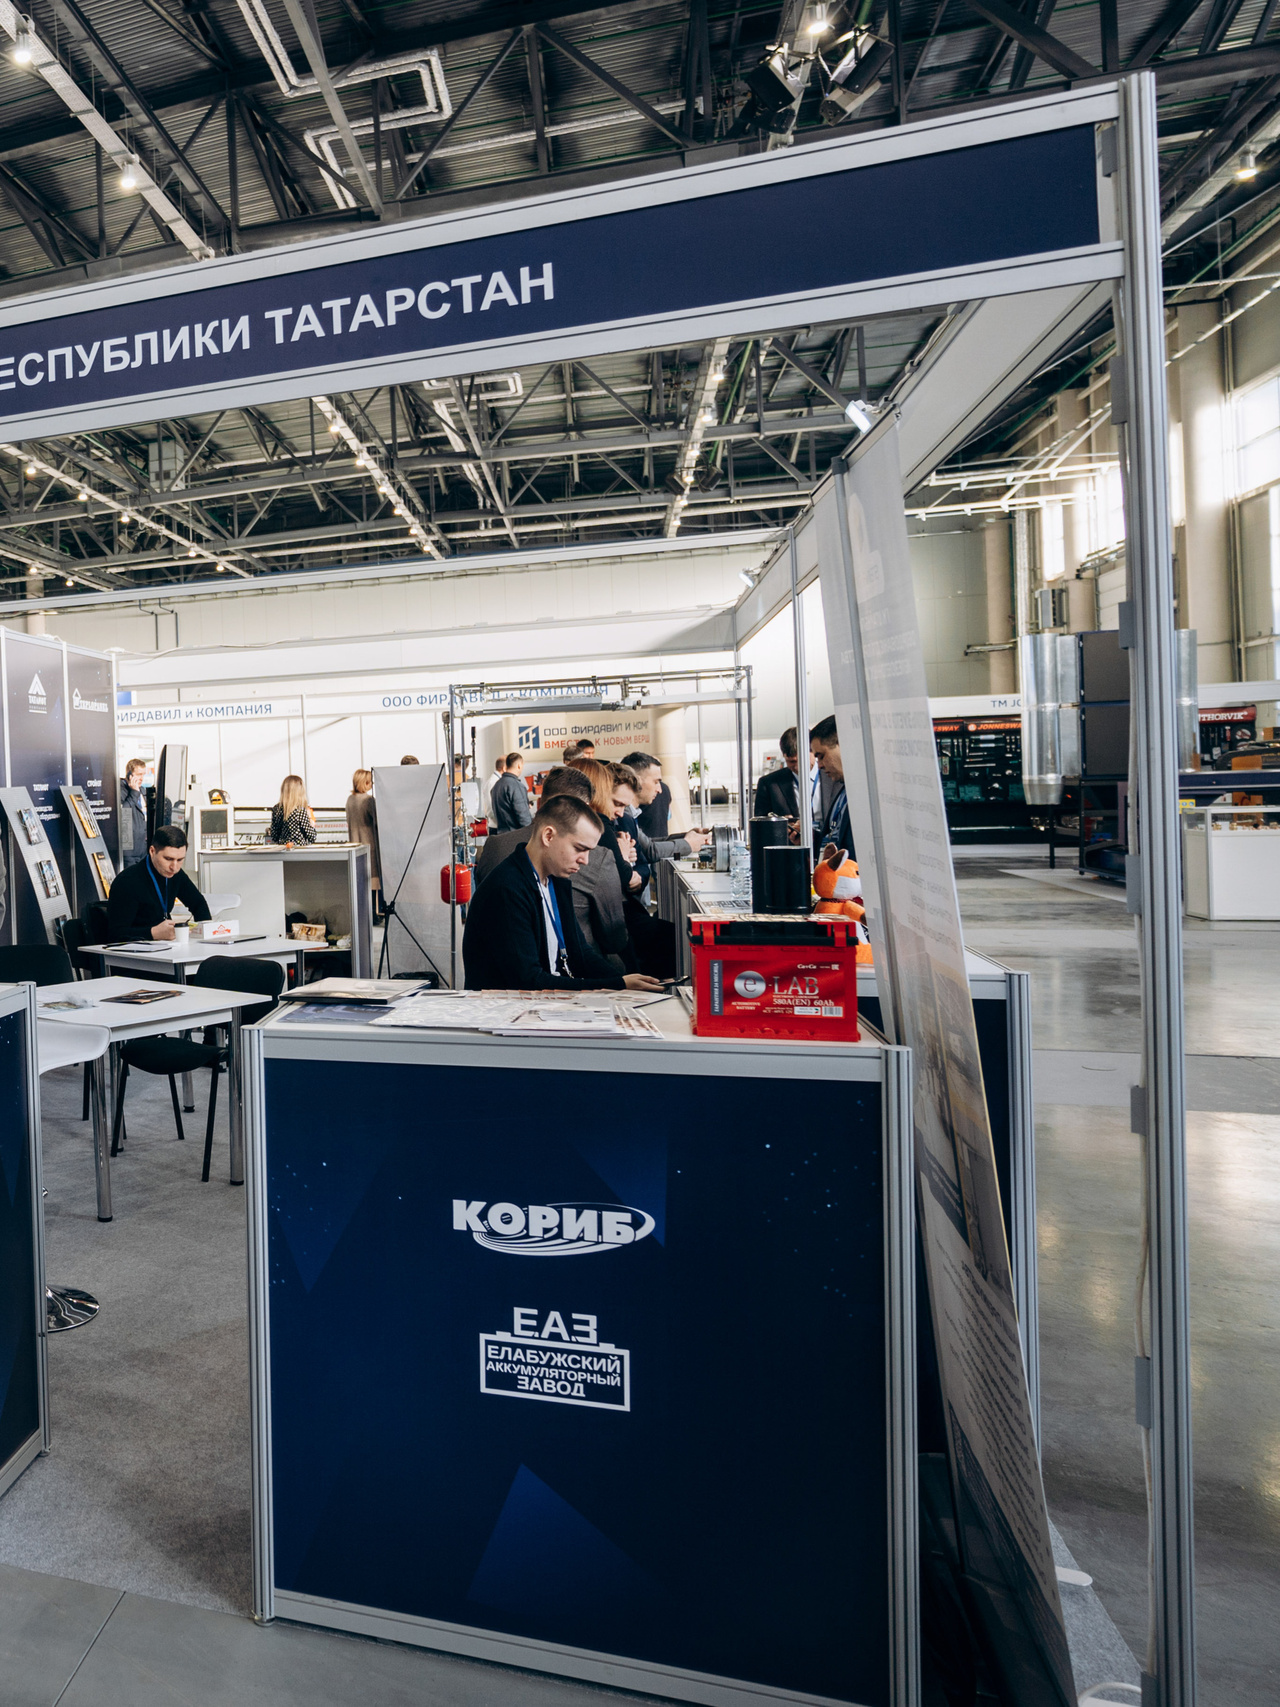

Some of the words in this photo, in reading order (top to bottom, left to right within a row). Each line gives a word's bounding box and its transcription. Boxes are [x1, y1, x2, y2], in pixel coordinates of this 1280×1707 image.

[265, 262, 554, 345] ТАТАРСТАН
[196, 703, 272, 718] КОМПАНИЯ
[382, 695, 412, 708] ООО
[543, 727, 568, 737] ООО
[603, 735, 632, 746] НОВЫМ
[452, 1198, 637, 1246] КОРИБ
[513, 1306, 598, 1345] ЕАЗ
[487, 1345, 621, 1374] ЕЛАБУЖСКИЙ
[486, 1360, 621, 1388] АККУМУЛЯТОРНЫЙ
[517, 1375, 586, 1398] ЗАВОД
